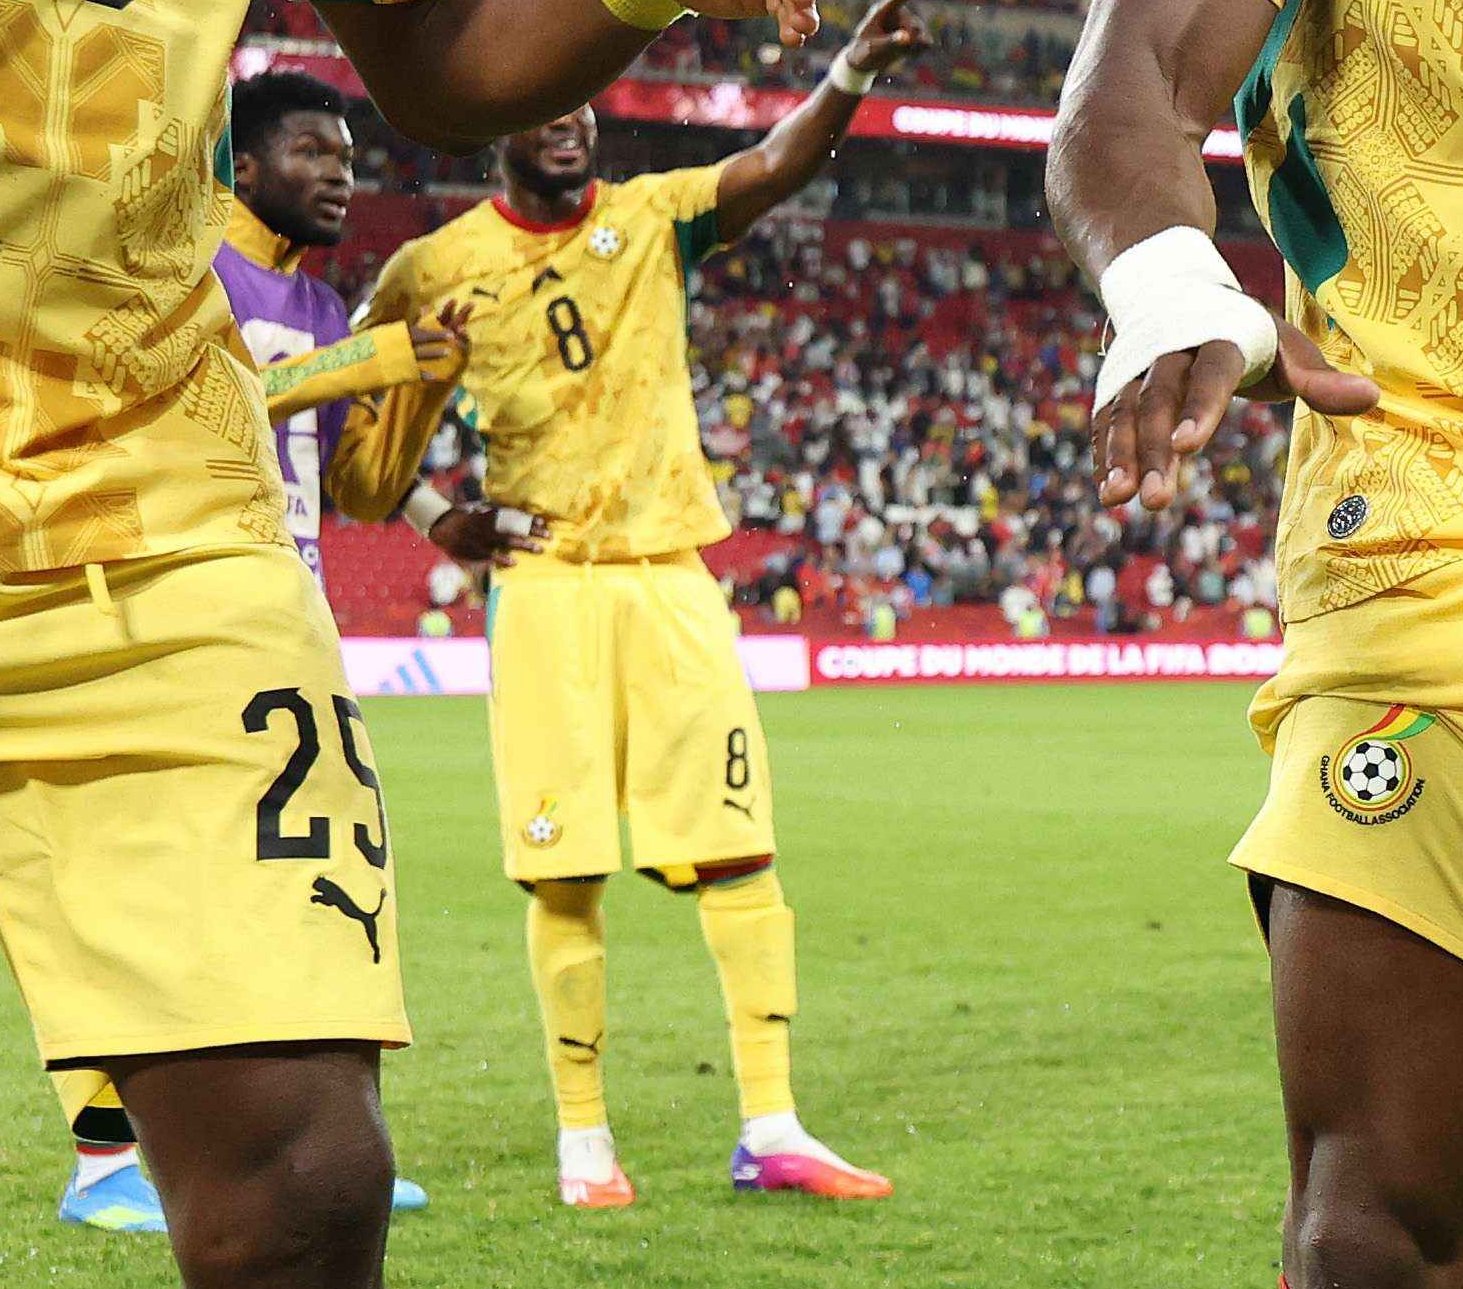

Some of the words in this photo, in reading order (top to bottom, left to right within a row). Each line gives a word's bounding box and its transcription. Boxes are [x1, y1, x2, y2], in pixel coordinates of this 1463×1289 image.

[547, 295, 593, 372] 8
[818, 645, 918, 678] COUPE
[1107, 645, 1145, 674] LA
[241, 687, 387, 869] 25
[726, 728, 748, 789] 8
[1320, 755, 1330, 793] GHANA
[1325, 792, 1374, 825] FOOTBALL
[1372, 778, 1426, 825] ASSOCIATION
